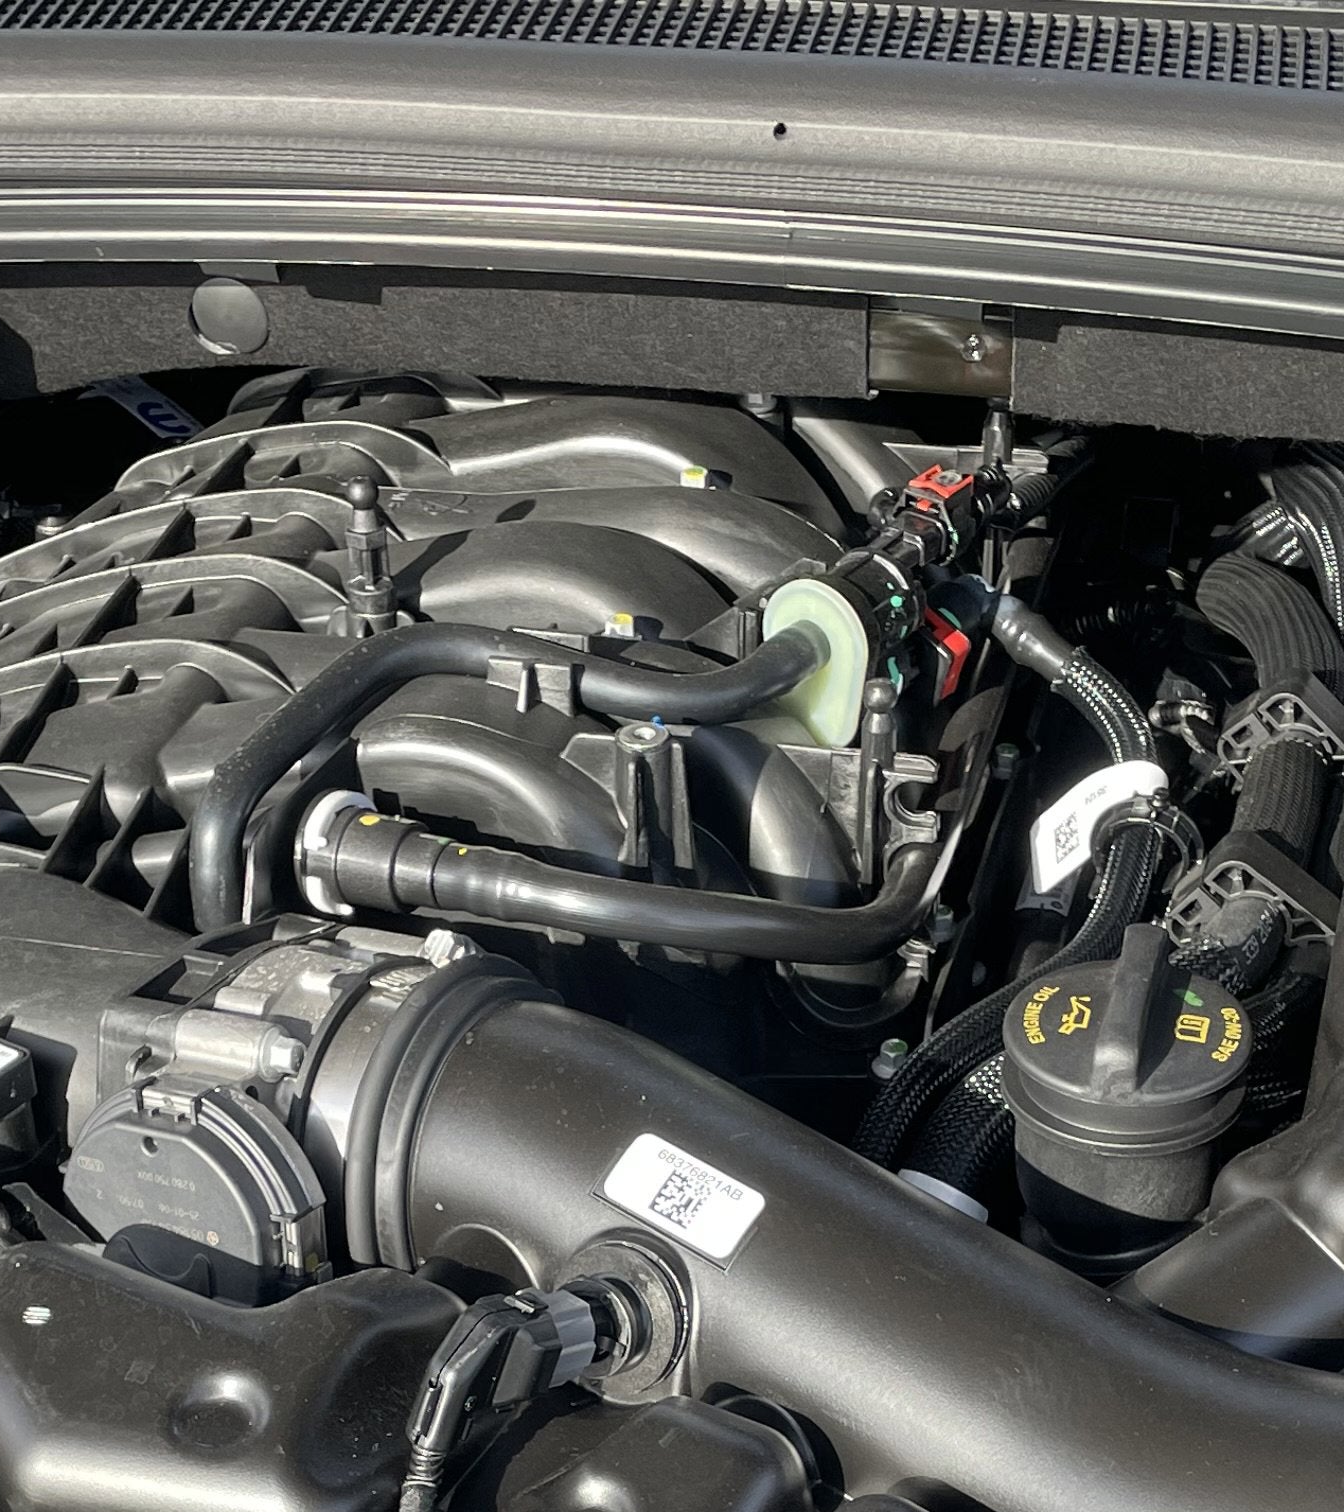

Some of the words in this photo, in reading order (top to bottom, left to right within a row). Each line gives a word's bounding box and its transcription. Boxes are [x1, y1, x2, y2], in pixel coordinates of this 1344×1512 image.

[1033, 986, 1060, 1003] OIL
[1023, 1002, 1046, 1045] ENGINE
[1220, 1007, 1242, 1040] 0W-20
[1210, 1038, 1239, 1062] SAE
[657, 1149, 744, 1202] 68376821AB
